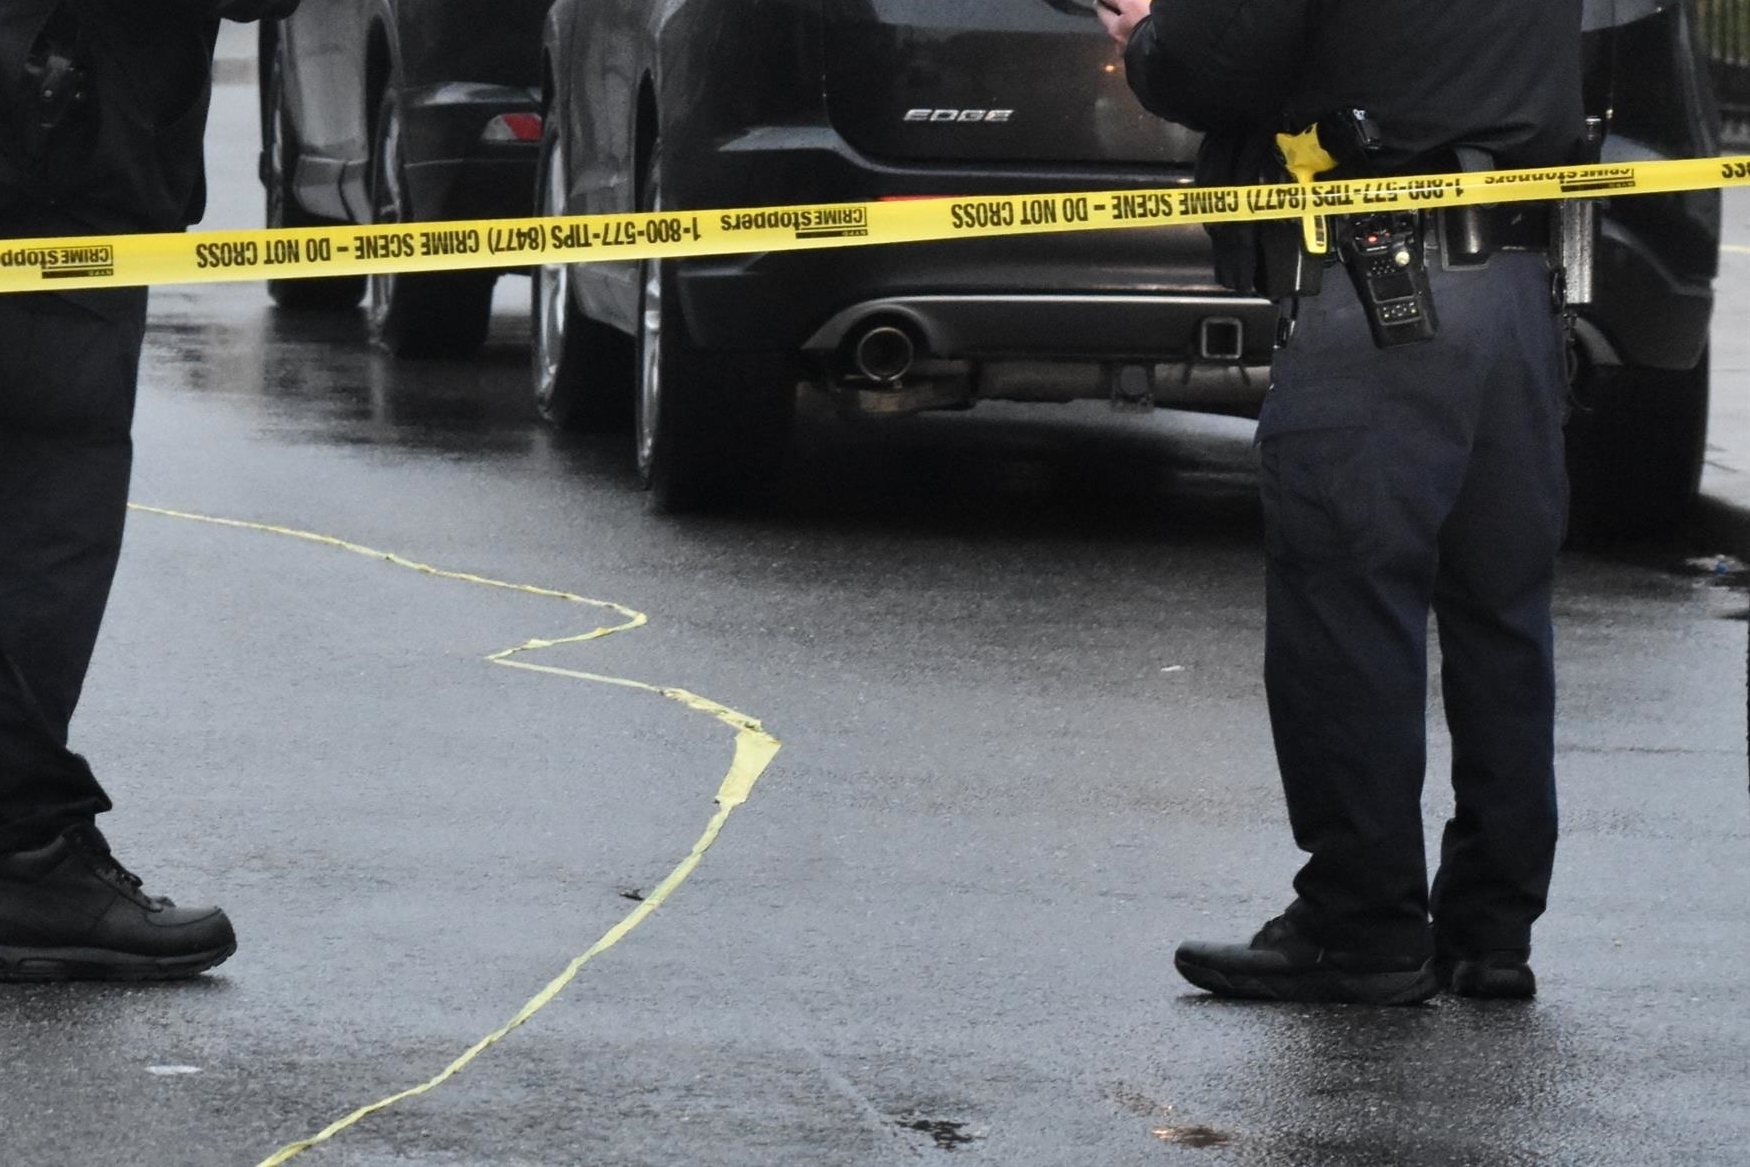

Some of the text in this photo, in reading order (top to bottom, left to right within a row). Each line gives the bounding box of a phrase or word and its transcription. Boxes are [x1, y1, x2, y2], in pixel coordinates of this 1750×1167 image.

[903, 109, 1014, 122] EDGE
[1063, 198, 1088, 222] DO
[1112, 194, 1172, 219] SCENE
[1179, 191, 1238, 215] CRIME
[1247, 183, 1306, 213] (8477)
[951, 202, 1013, 228] CROSS
[1020, 200, 1056, 225] NOT
[420, 230, 479, 256] CRIME
[488, 225, 546, 254] (8477)
[551, 217, 701, 249] 1-800-577-TIPS
[196, 241, 257, 268] CROSS
[264, 240, 299, 264] NOT
[306, 238, 331, 262] DO
[354, 233, 414, 259] SCENE
